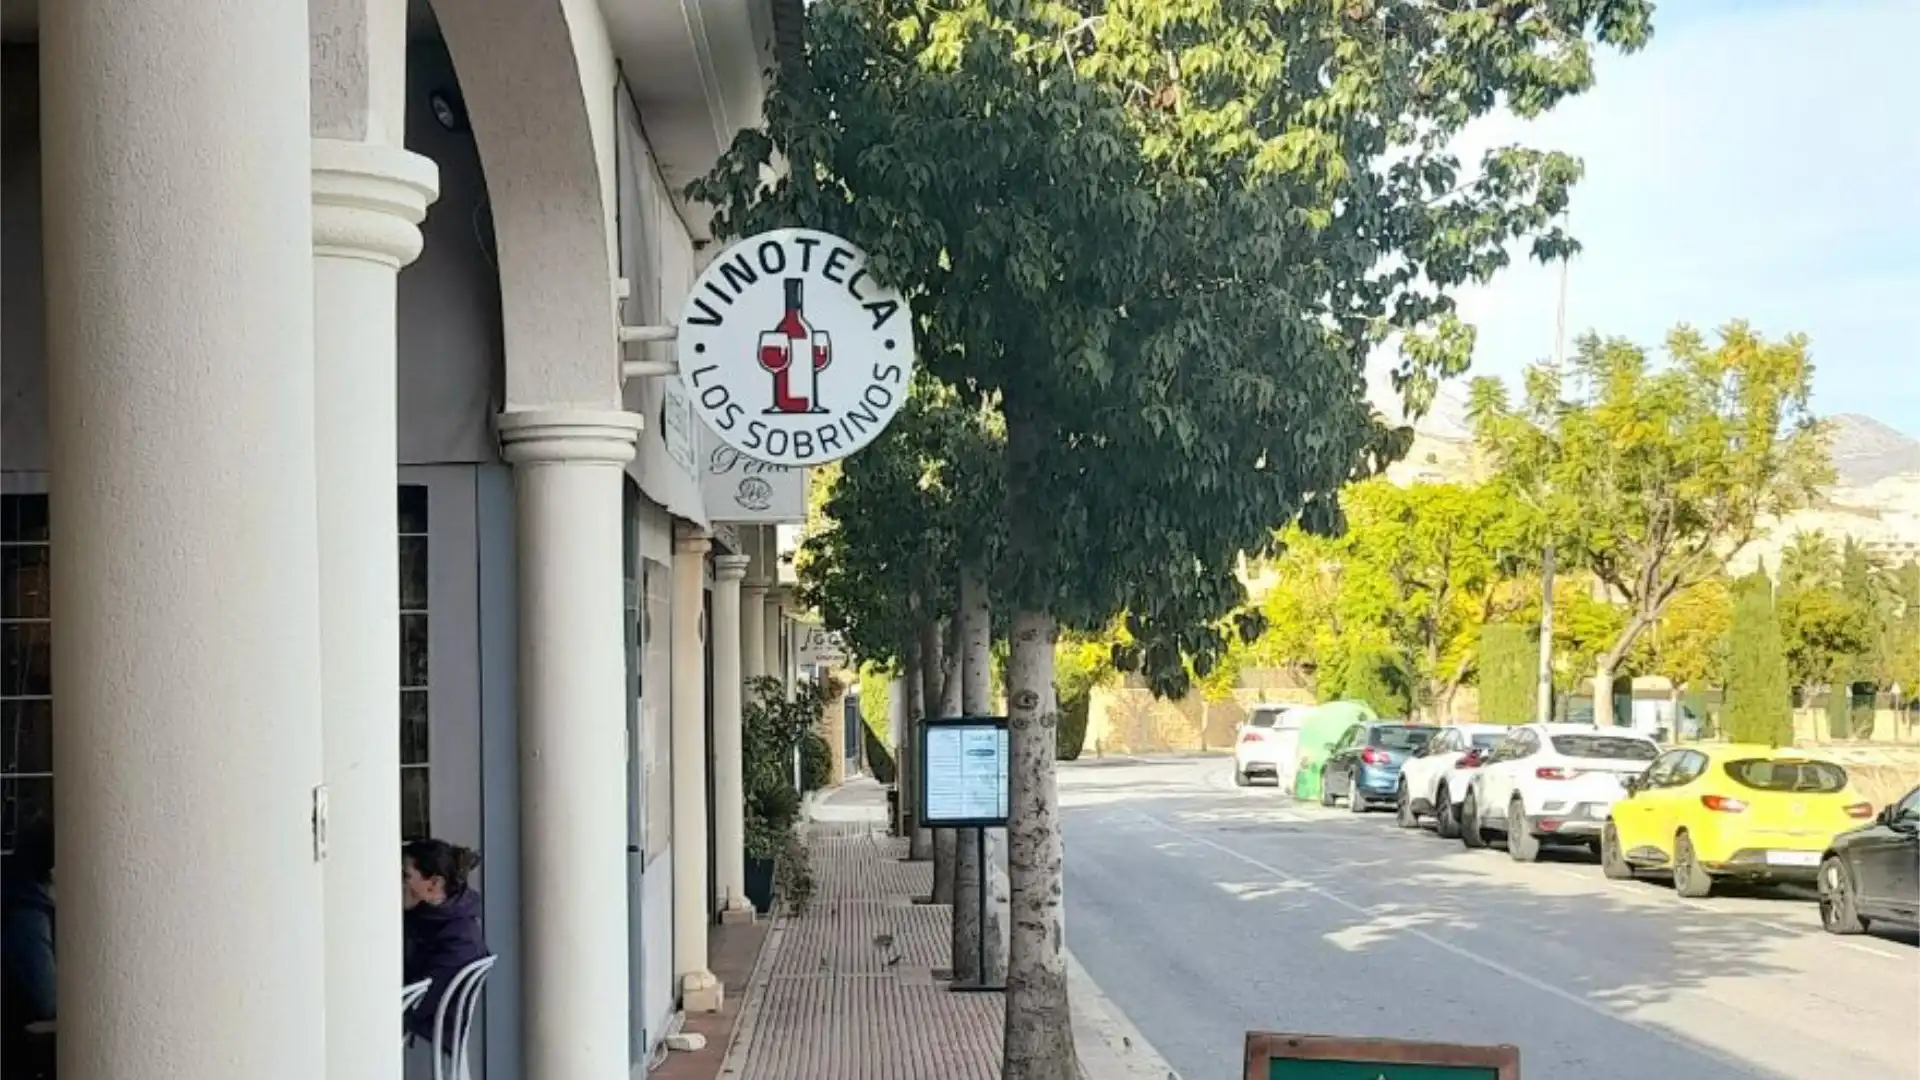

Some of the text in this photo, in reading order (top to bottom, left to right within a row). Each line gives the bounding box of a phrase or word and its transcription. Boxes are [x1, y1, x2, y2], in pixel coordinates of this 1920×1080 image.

[687, 237, 899, 330] VINOTECA
[692, 364, 745, 431] LOS
[742, 363, 900, 459] SOBRINOS
